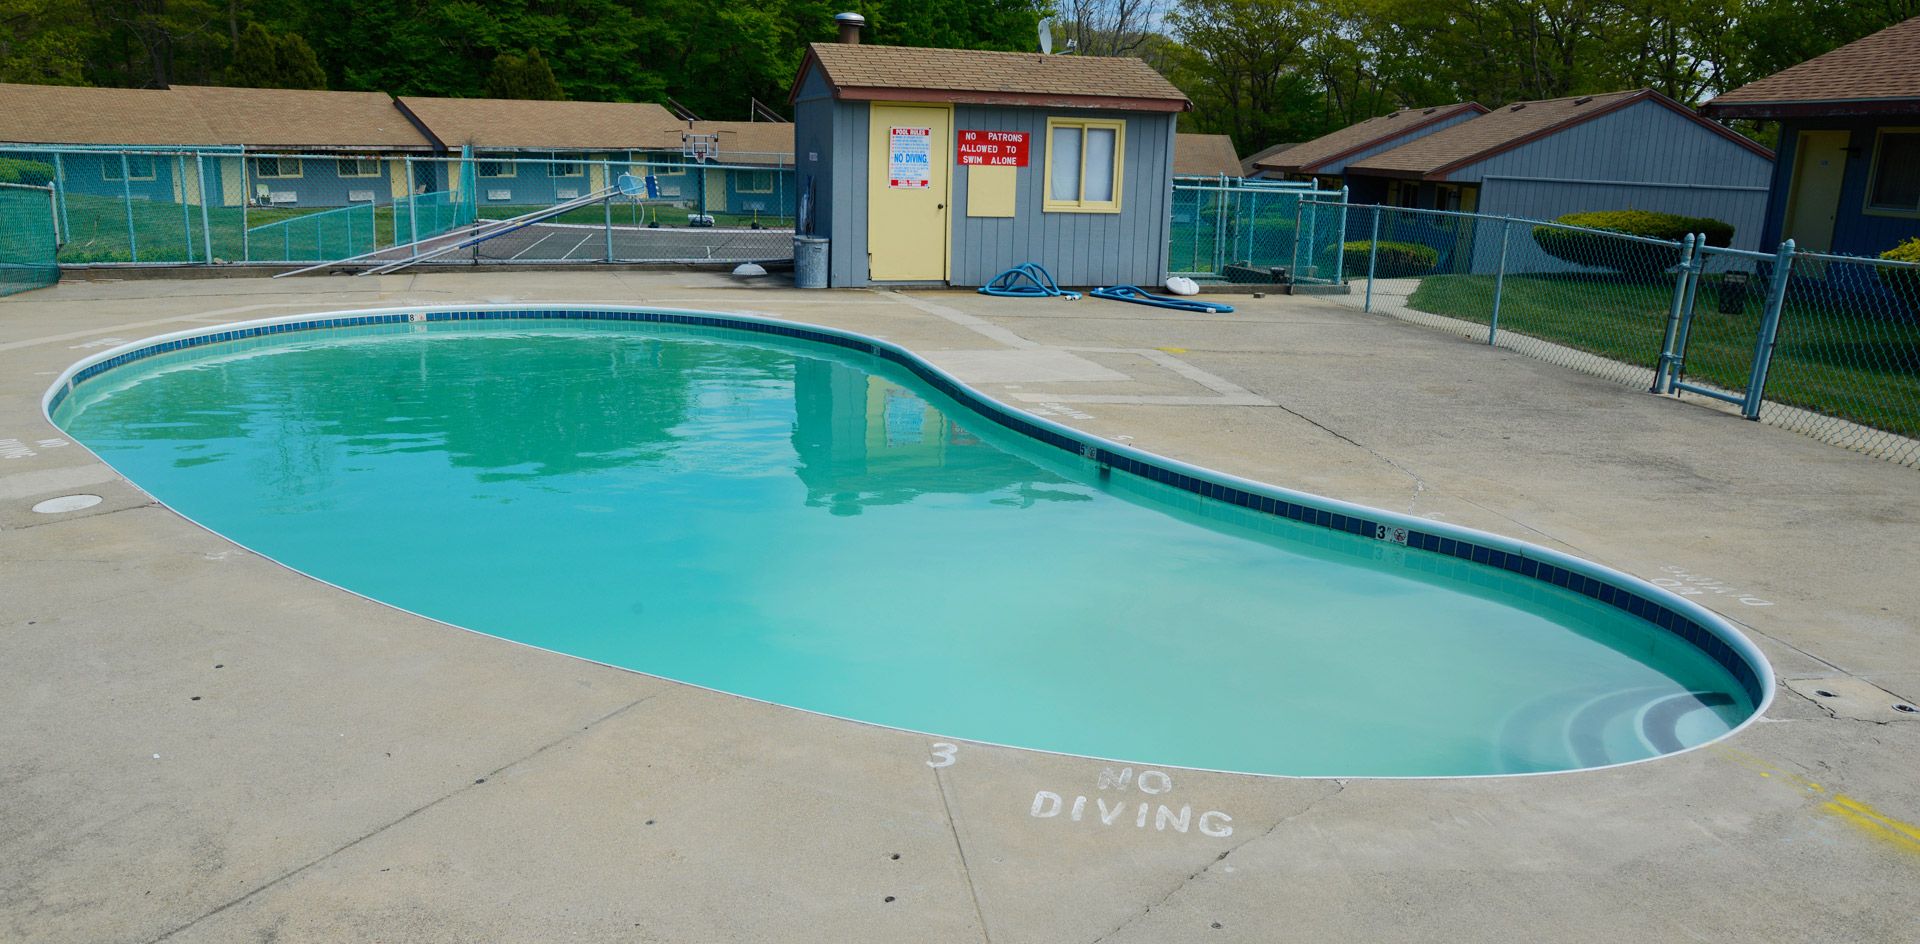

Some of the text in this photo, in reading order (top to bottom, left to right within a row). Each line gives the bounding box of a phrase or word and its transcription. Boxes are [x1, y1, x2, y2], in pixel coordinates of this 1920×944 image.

[965, 132, 1023, 142] NO PATRONS
[960, 145, 1017, 154] ALLOWED TO
[894, 153, 903, 163] NO
[962, 156, 1017, 165] SWIM ALONE
[925, 742, 958, 769] 3
[1098, 767, 1172, 795] NO
[1030, 790, 1233, 838] DIVING
